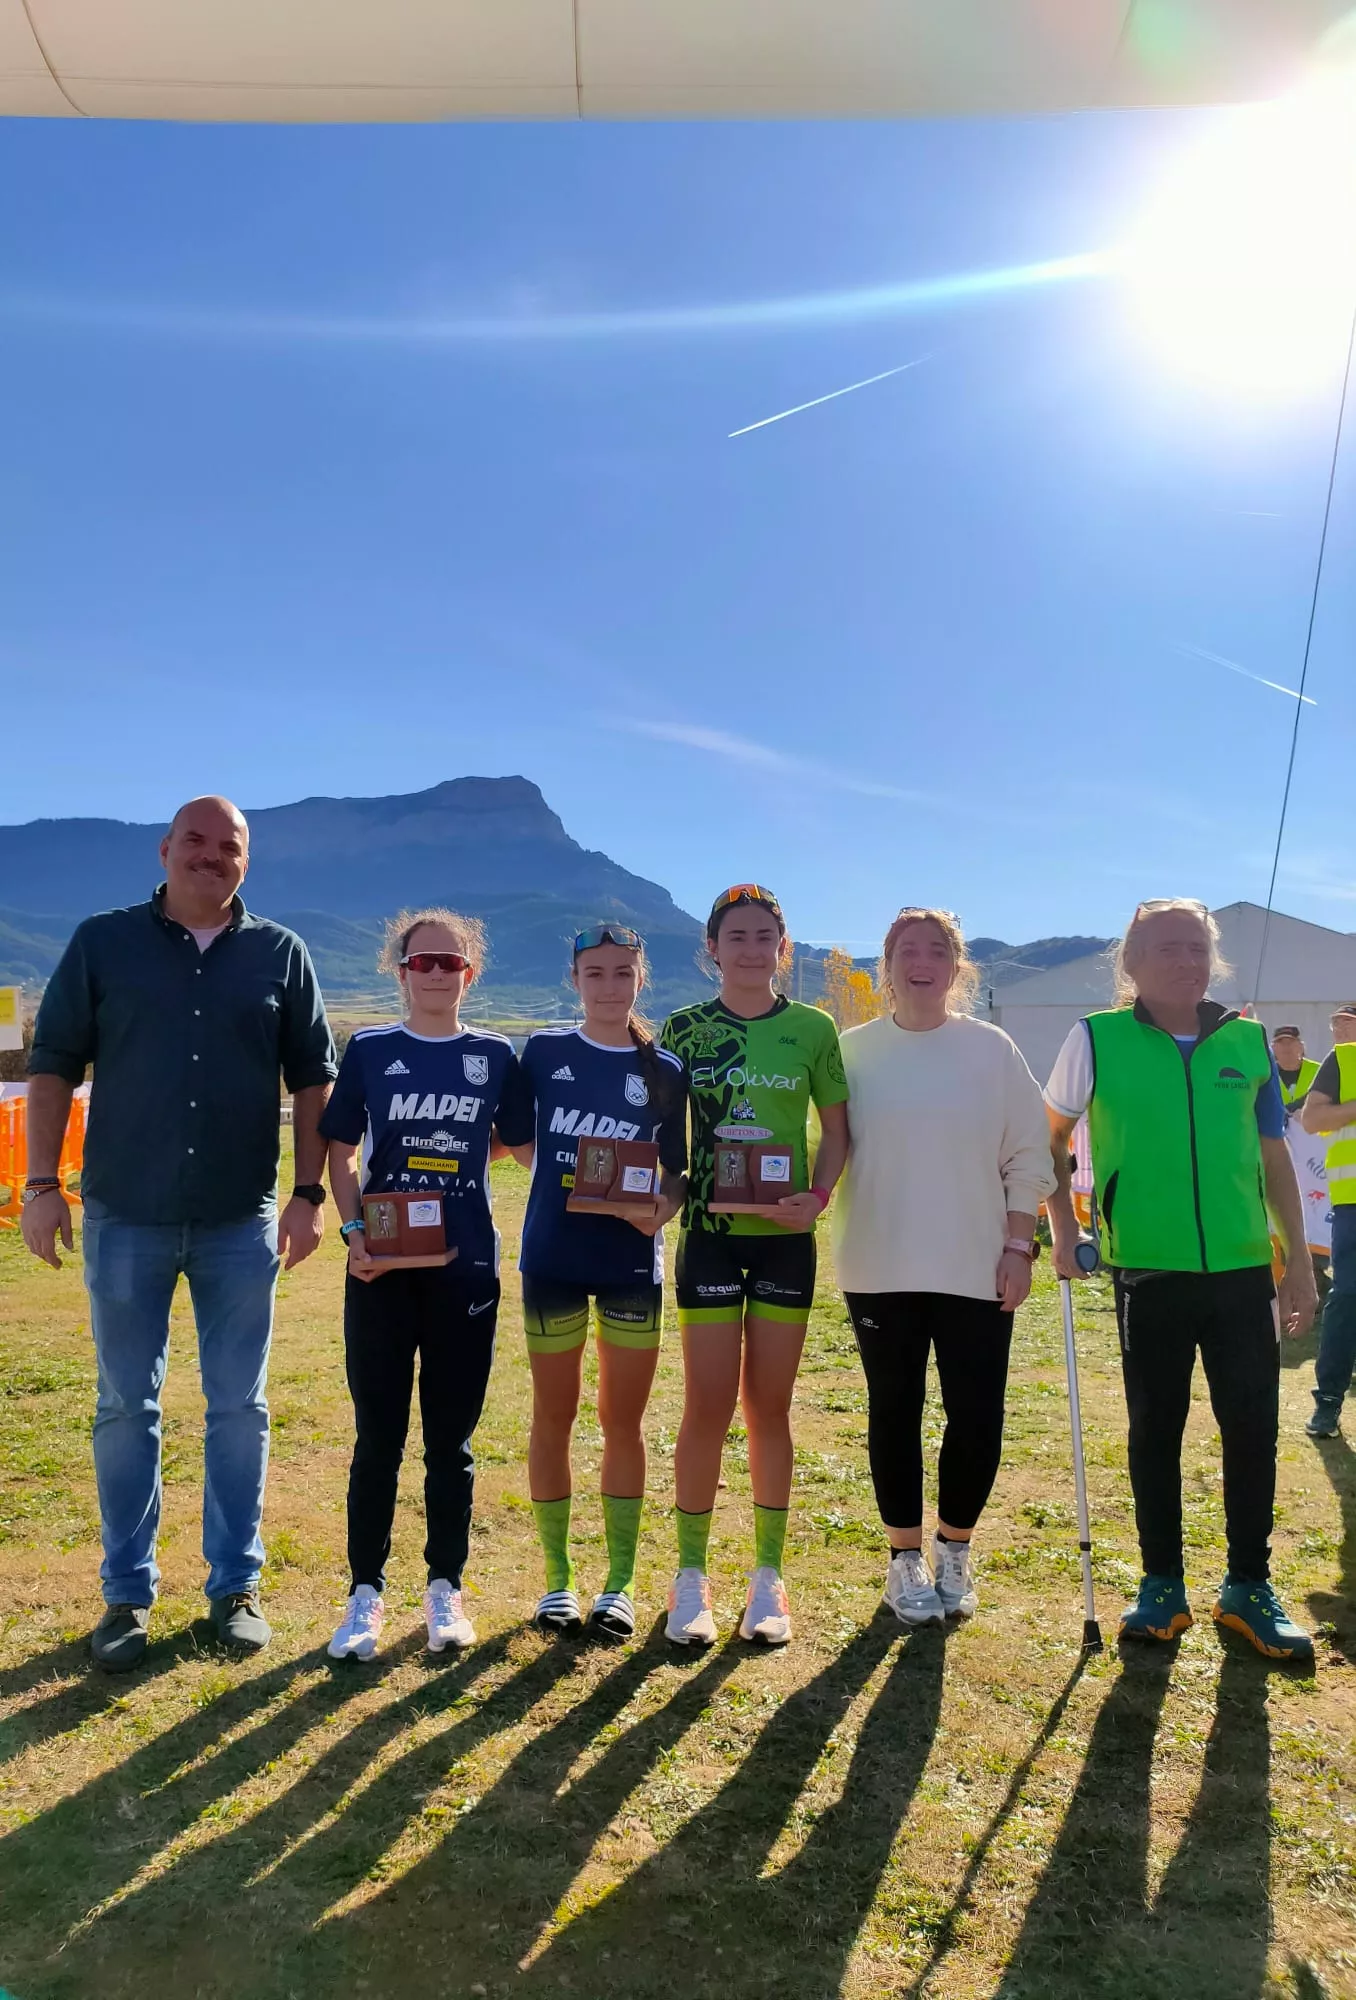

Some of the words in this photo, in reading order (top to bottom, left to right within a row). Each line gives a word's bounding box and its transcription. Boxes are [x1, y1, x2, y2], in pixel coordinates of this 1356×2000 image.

[551, 1074, 576, 1082] adidas
[691, 1065, 716, 1087] El
[726, 1065, 801, 1091] Olivar
[388, 1093, 481, 1123] MAPEI
[386, 1173, 477, 1190] PRAVIA
